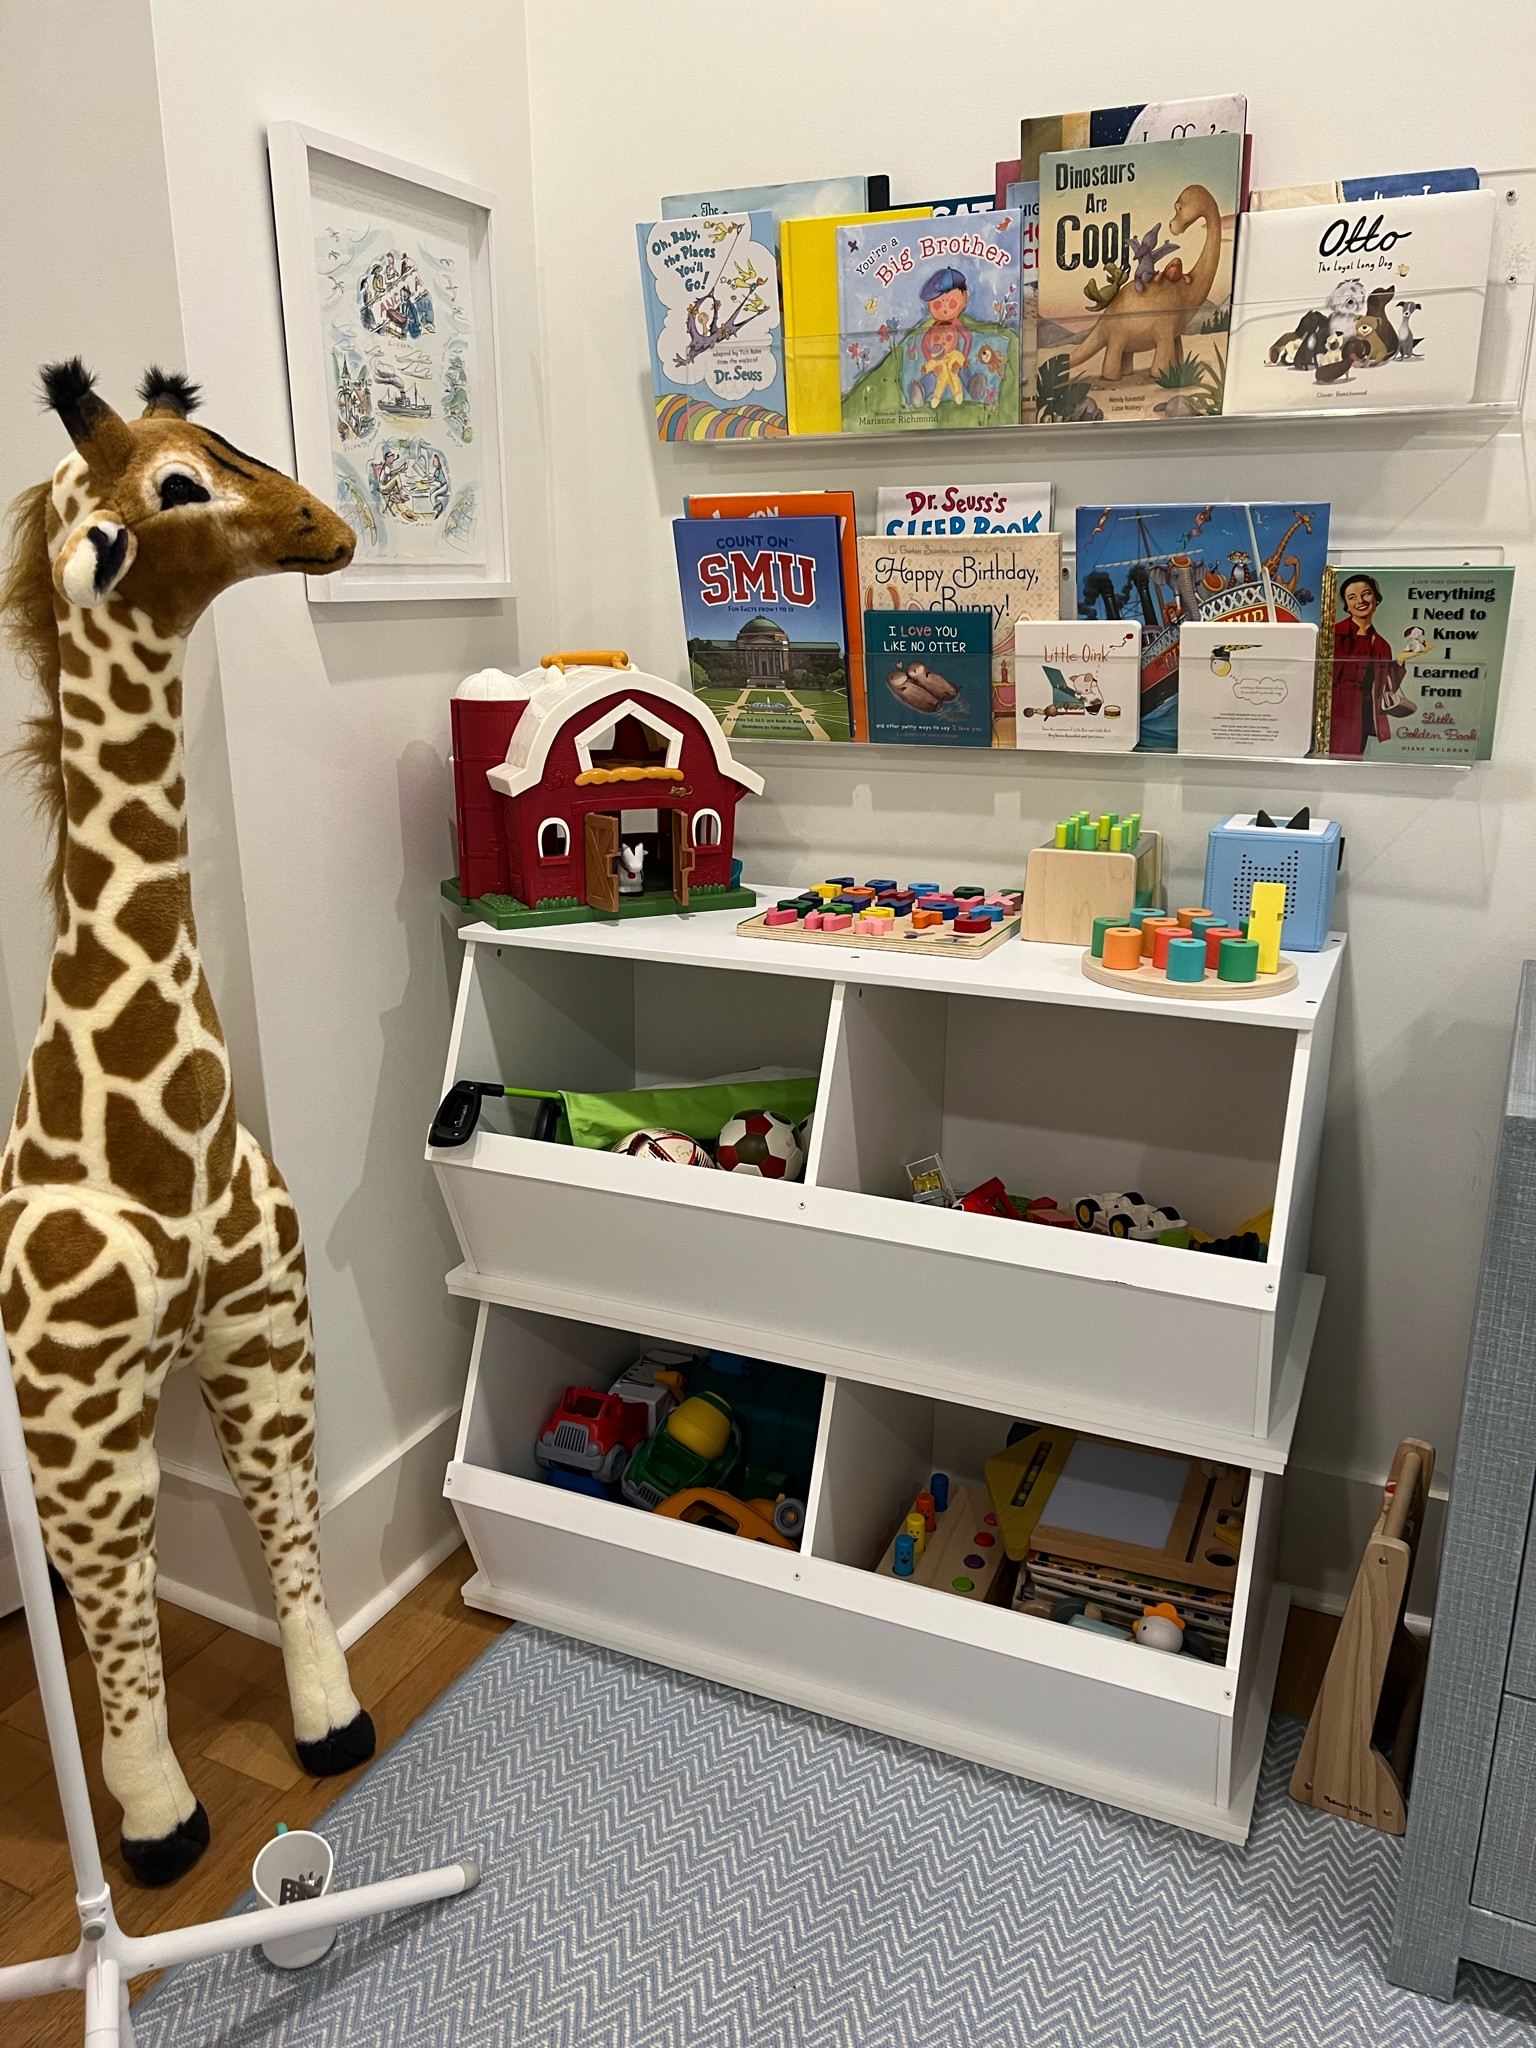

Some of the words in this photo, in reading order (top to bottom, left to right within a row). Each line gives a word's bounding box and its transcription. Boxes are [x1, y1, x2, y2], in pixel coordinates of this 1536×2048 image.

[1056, 162, 1135, 191] Dinosaurs
[700, 202, 719, 216] The
[1086, 193, 1108, 214] Are
[1056, 212, 1131, 271] Cool
[1318, 214, 1413, 257] Otto
[652, 240, 671, 256] Oh,
[664, 253, 681, 268] the
[680, 245, 716, 259] Places
[855, 244, 888, 277] You're
[890, 237, 898, 247] a
[675, 261, 704, 278] You'll
[875, 247, 914, 287] Big
[919, 234, 1011, 268] Brother
[1318, 261, 1331, 274] The
[1356, 258, 1375, 272] Long
[1378, 255, 1393, 270] Dog
[685, 271, 710, 292] Go!
[713, 369, 732, 385] Dr.
[733, 365, 763, 382] Seuss
[858, 416, 896, 426] Marianne
[898, 414, 939, 424] Richmond
[906, 491, 938, 516] Dr.
[941, 487, 1008, 513] Seuss's
[716, 535, 764, 550] COUNT
[697, 550, 817, 608] SMU
[875, 556, 944, 592] Happy
[952, 553, 1039, 591] Birthday,
[1408, 587, 1496, 603] Everything
[929, 586, 1010, 630] Bunny!
[1412, 607, 1419, 620] I
[1424, 607, 1464, 620] Need
[1470, 608, 1486, 620] to
[889, 626, 896, 636] I
[935, 626, 958, 638] YOU
[1433, 627, 1479, 640] Know
[911, 641, 925, 652] NO
[928, 641, 966, 653] OTTER
[1044, 643, 1078, 663] Little
[1082, 643, 1108, 663] Oink
[1444, 647, 1451, 659] I
[1413, 666, 1479, 679] Learned
[1421, 685, 1462, 697] From
[1421, 712, 1455, 725] Little
[1396, 726, 1442, 740] Golden
[1444, 728, 1477, 741] Book
